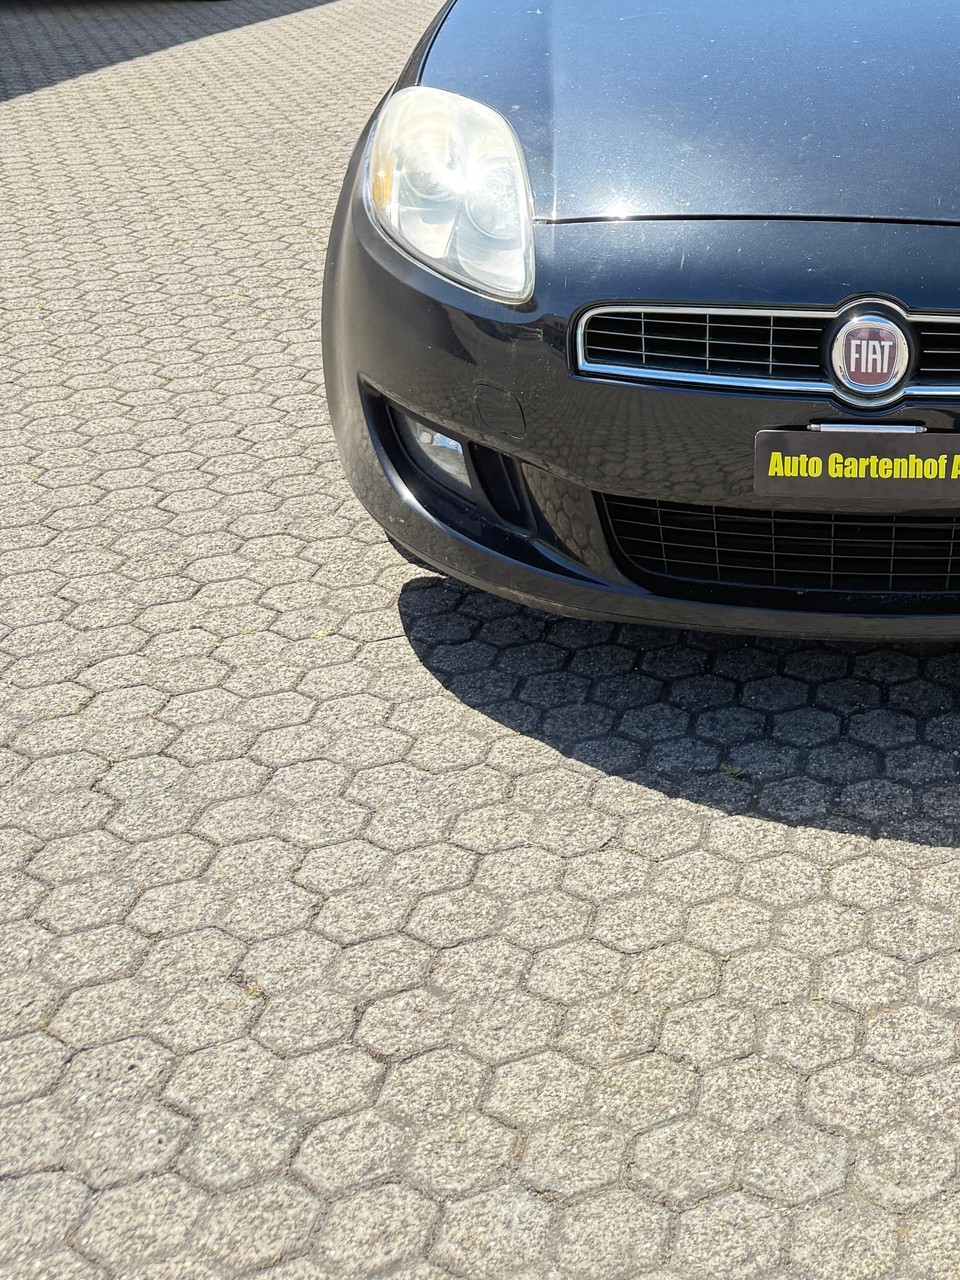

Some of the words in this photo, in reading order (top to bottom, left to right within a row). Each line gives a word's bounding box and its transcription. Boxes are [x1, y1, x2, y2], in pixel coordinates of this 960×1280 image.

[850, 339, 893, 373] FIAT
[768, 451, 821, 477] Auto
[828, 452, 947, 479] Gartenhof
